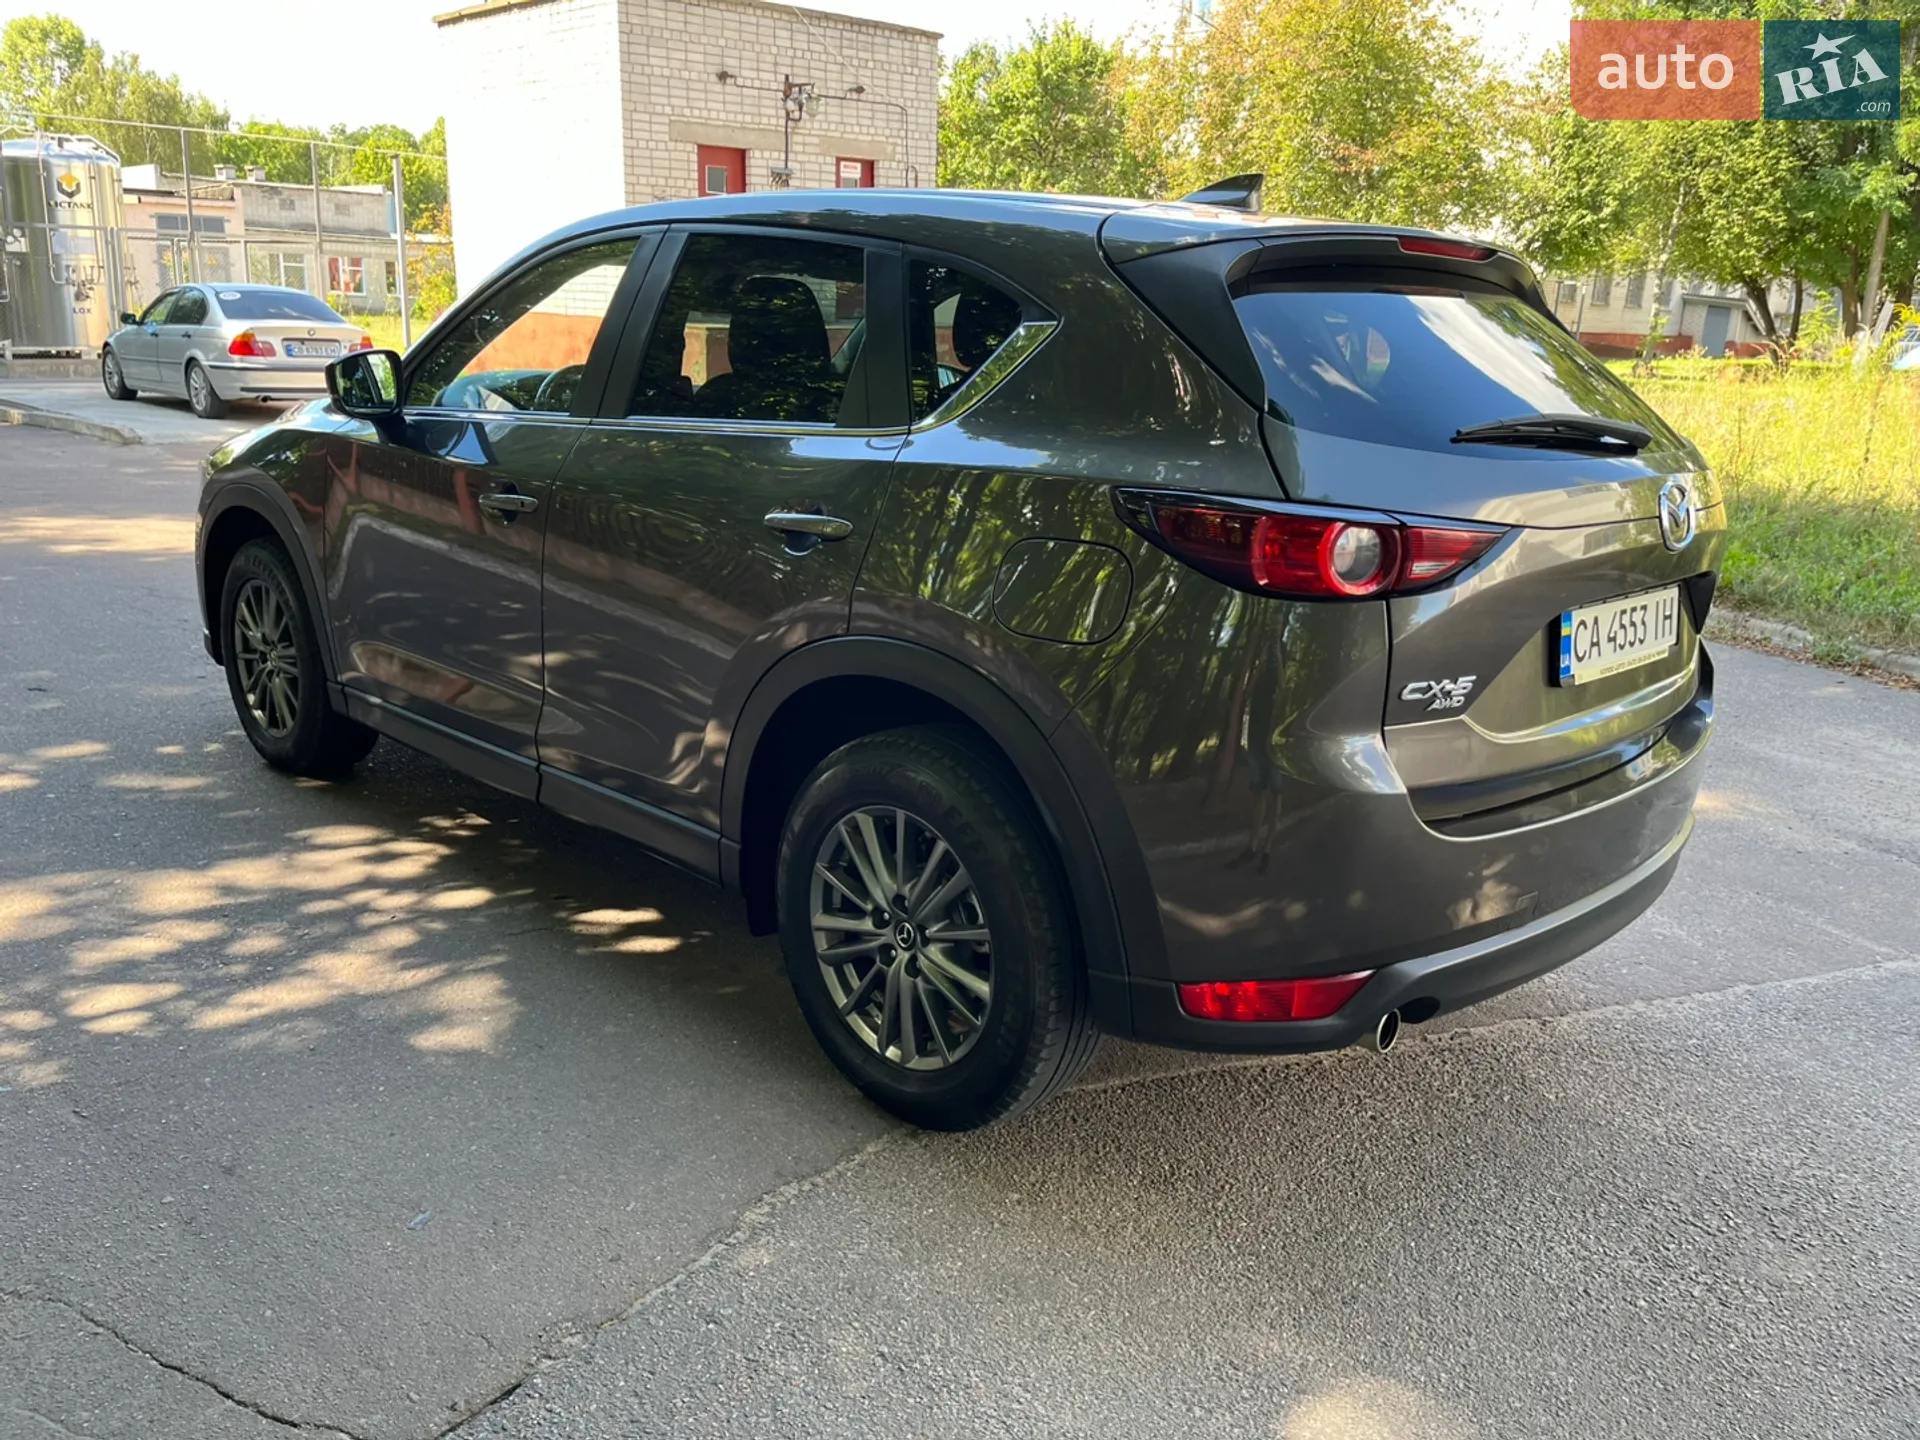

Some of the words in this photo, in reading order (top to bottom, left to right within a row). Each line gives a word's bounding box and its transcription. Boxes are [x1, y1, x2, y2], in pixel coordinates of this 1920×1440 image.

[1574, 615, 1601, 663] CA
[1607, 603, 1648, 654] 4553
[1654, 596, 1674, 640] IH
[1401, 675, 1477, 700] CX-5
[1425, 696, 1465, 711] AWD
